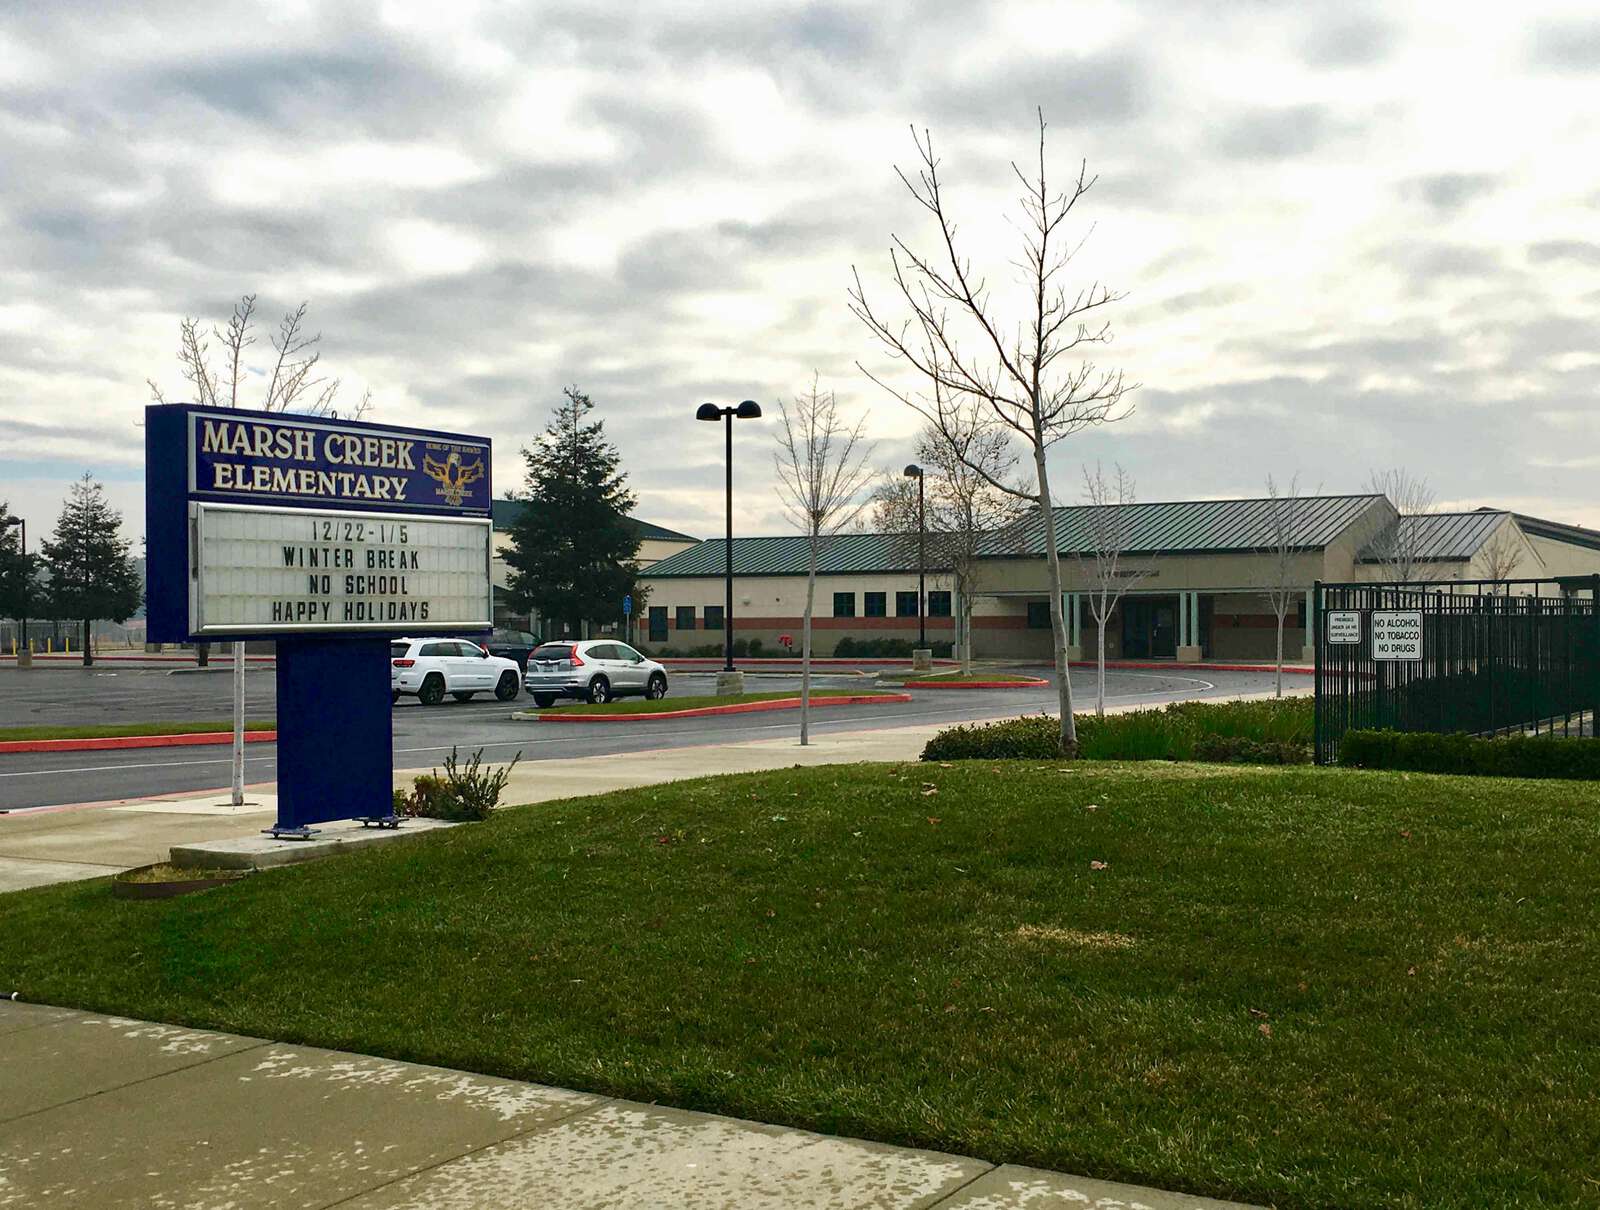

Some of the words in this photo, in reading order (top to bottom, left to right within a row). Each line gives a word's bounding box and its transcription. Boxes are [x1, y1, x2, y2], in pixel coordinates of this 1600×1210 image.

[202, 420, 316, 461] MARSH
[323, 434, 416, 470] CREEK
[213, 463, 408, 500] ELEMENTARY
[283, 546, 353, 569] WINTER
[367, 550, 420, 570] BREAK
[309, 575, 331, 595] NO
[346, 575, 409, 595] SCHOOL
[272, 602, 331, 621] HAPPY
[344, 602, 429, 621] HOLIDAYS
[1374, 619, 1385, 628] NO
[1386, 618, 1420, 628] ALCOHOL
[1374, 631, 1385, 640] NO
[1387, 631, 1420, 640] TOBACCO
[1378, 644, 1389, 653] NO
[1391, 644, 1416, 653] DRUGS
